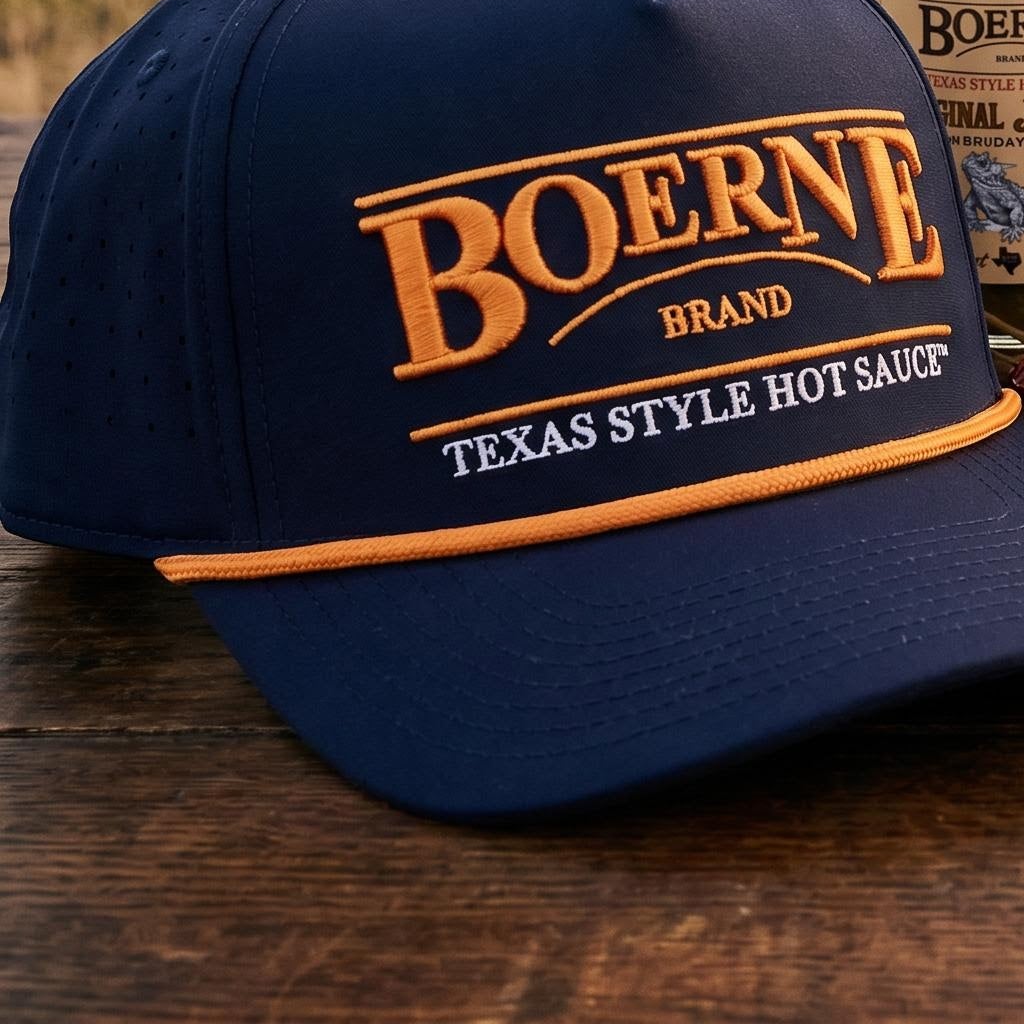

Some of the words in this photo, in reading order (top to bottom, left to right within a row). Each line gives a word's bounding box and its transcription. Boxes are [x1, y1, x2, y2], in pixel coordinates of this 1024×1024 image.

[970, 77, 1015, 91] STYLE
[937, 99, 1005, 130] GINAL
[963, 136, 1024, 147] BRUDAY
[359, 126, 945, 381] BOERNE
[658, 283, 793, 340] BRAND
[442, 412, 598, 479] TEXAS
[607, 381, 756, 444] STYLE
[762, 360, 848, 412] HOT
